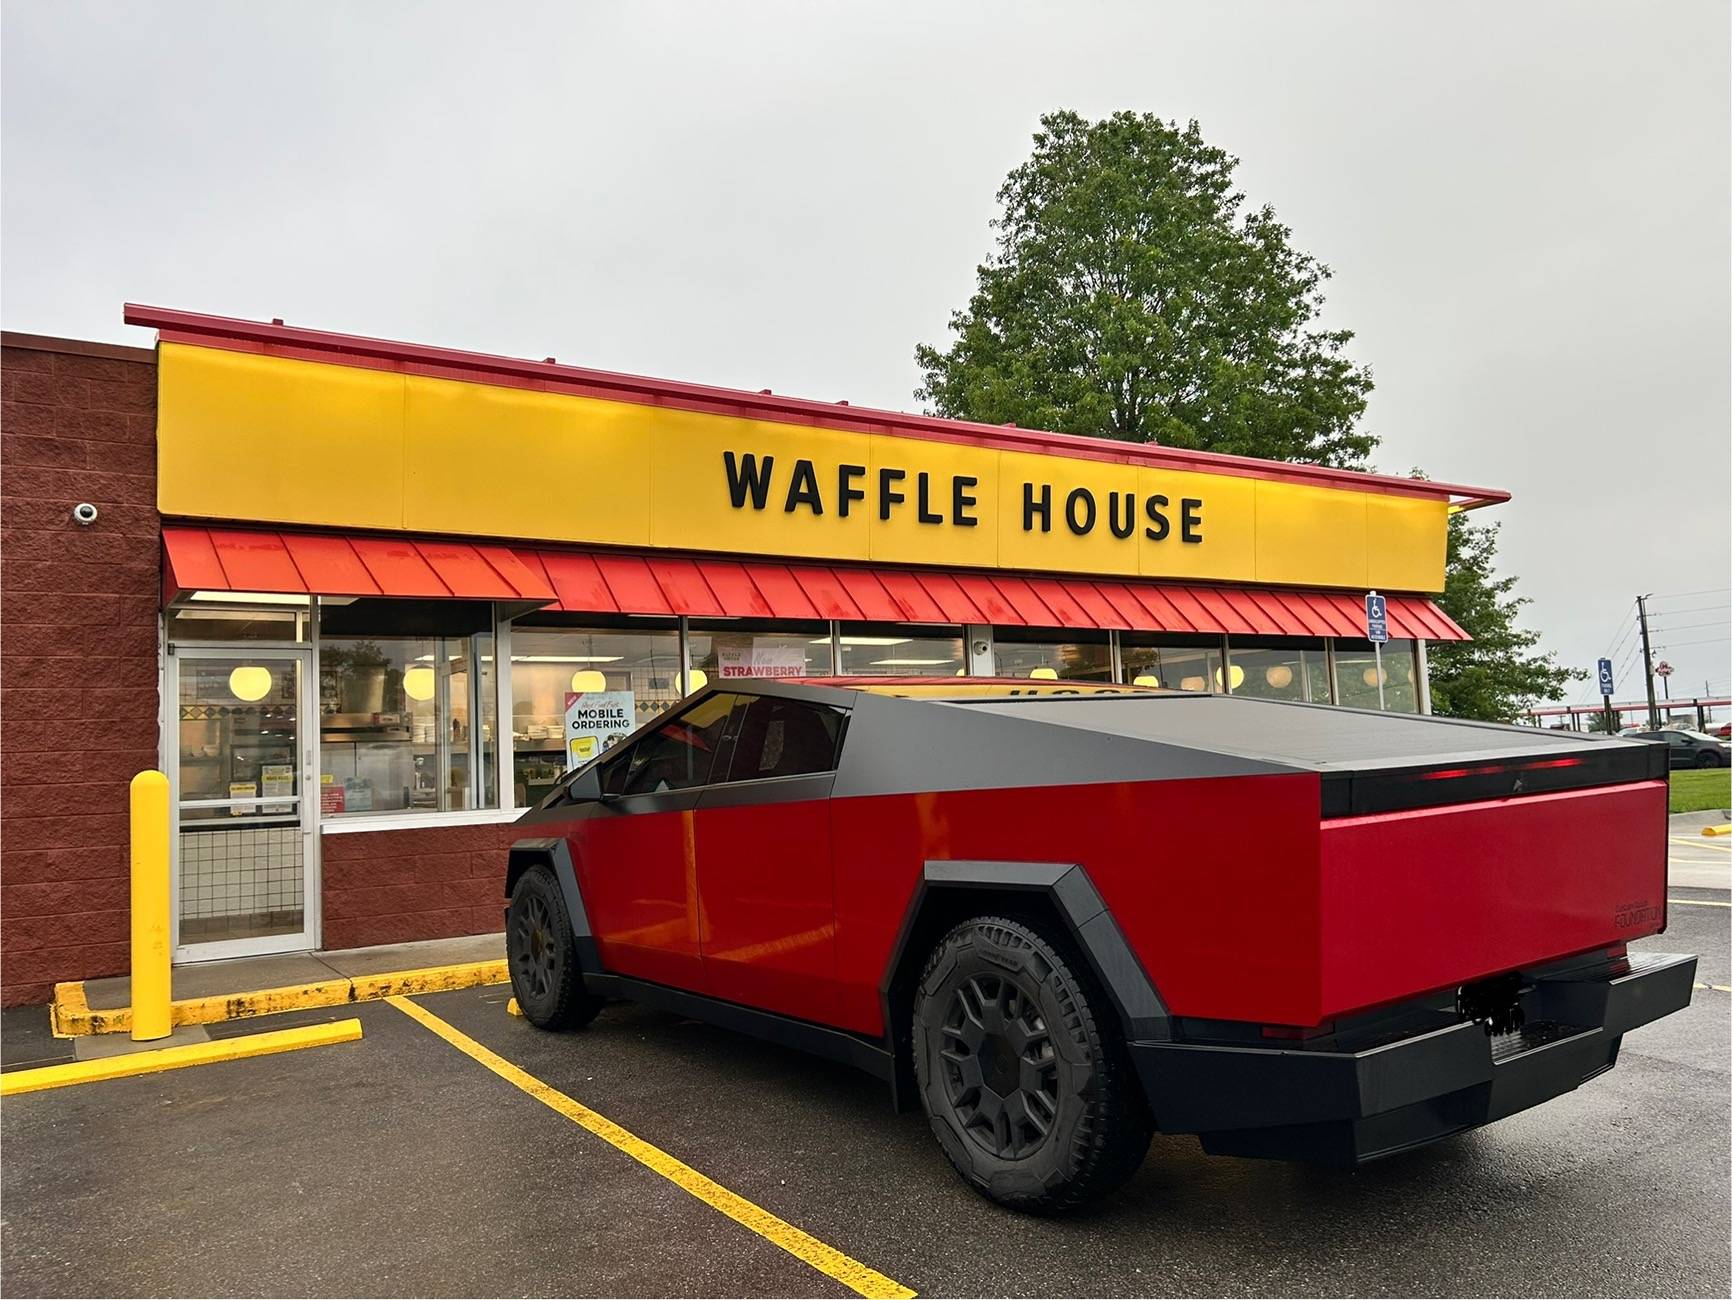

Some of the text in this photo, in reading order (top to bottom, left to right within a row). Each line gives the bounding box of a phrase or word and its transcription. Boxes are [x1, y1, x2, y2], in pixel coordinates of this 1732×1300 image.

[723, 451, 1203, 544] WAFFLE HOUSE
[723, 666, 802, 677] STRAWBERRY
[578, 709, 624, 719] MOBILE
[572, 719, 630, 730] ORDERING
